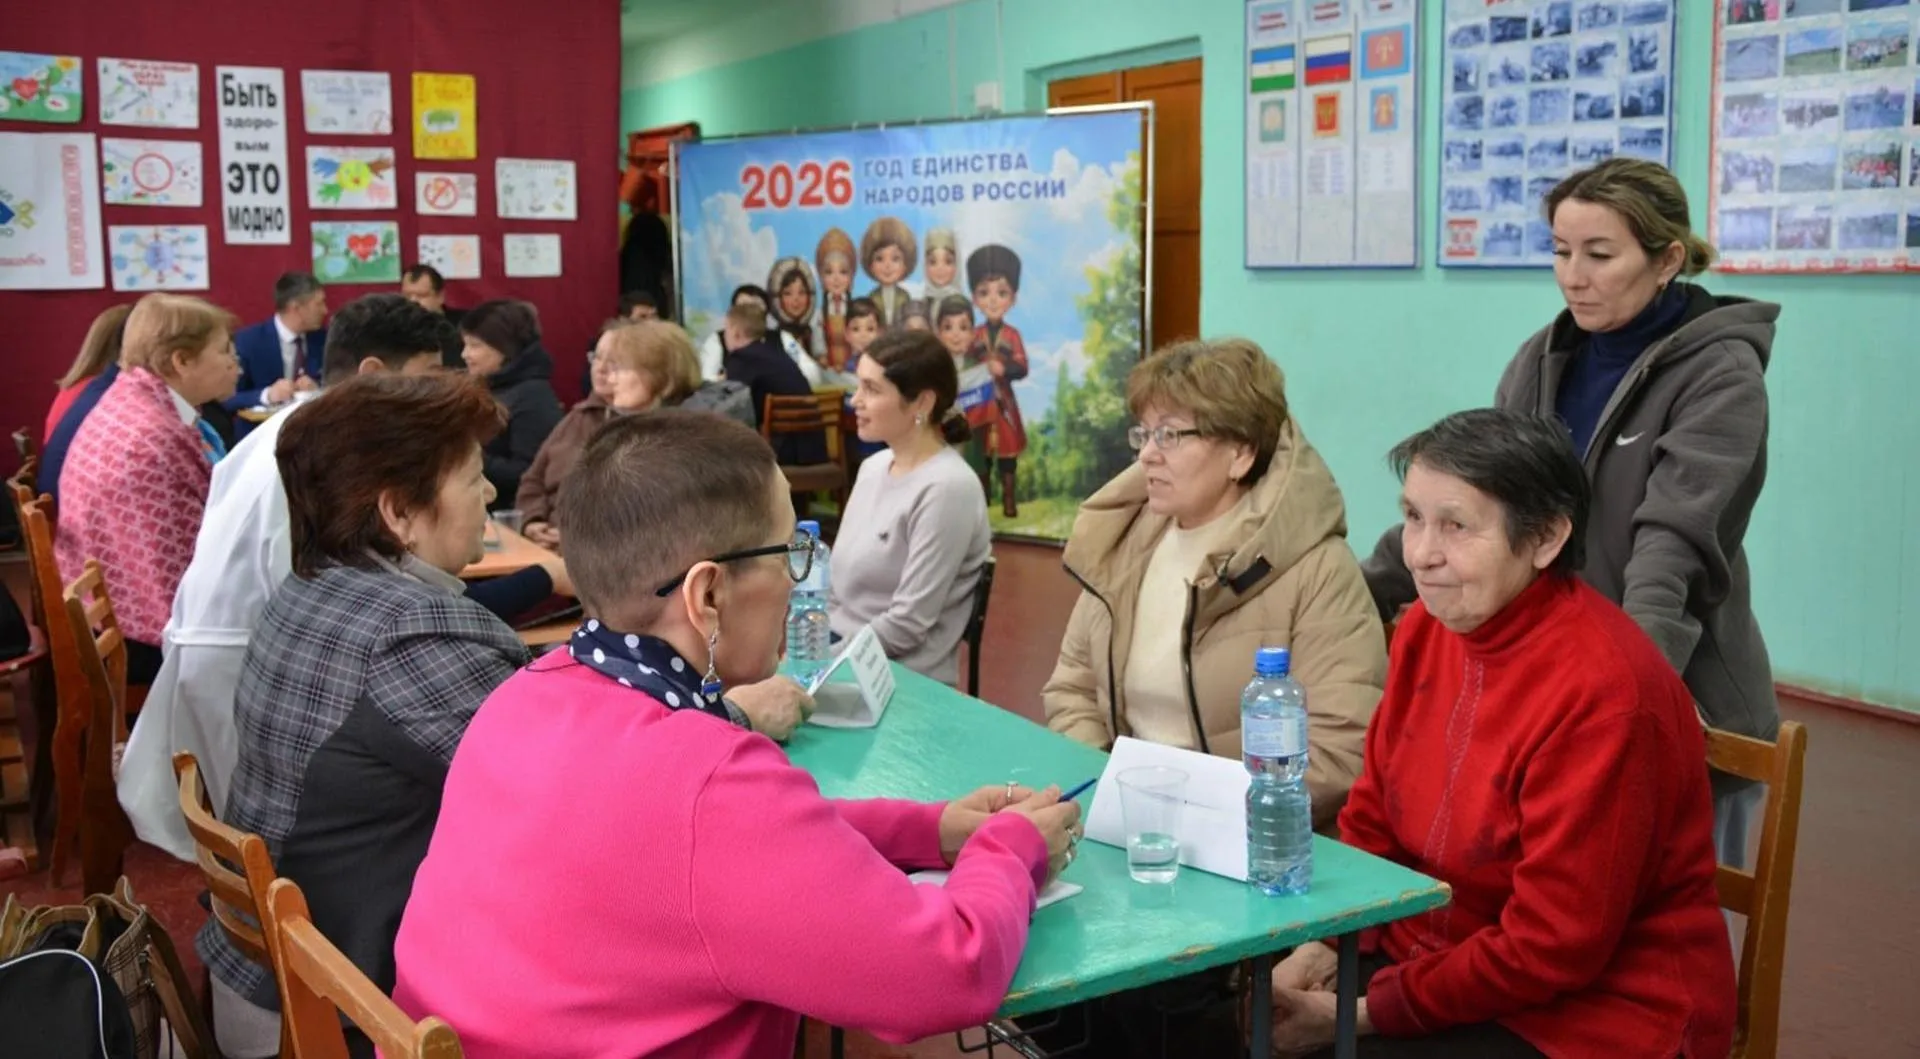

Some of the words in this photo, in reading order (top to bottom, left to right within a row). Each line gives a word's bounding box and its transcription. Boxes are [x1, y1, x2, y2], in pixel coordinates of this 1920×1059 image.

[227, 163, 280, 194] ЭТО
[864, 159, 903, 178] ГОД
[912, 153, 1028, 177] ЕДИНСТВА
[742, 162, 852, 208] 2026
[864, 185, 965, 206] НАРОДОВ
[972, 178, 1066, 200] РОССИИ
